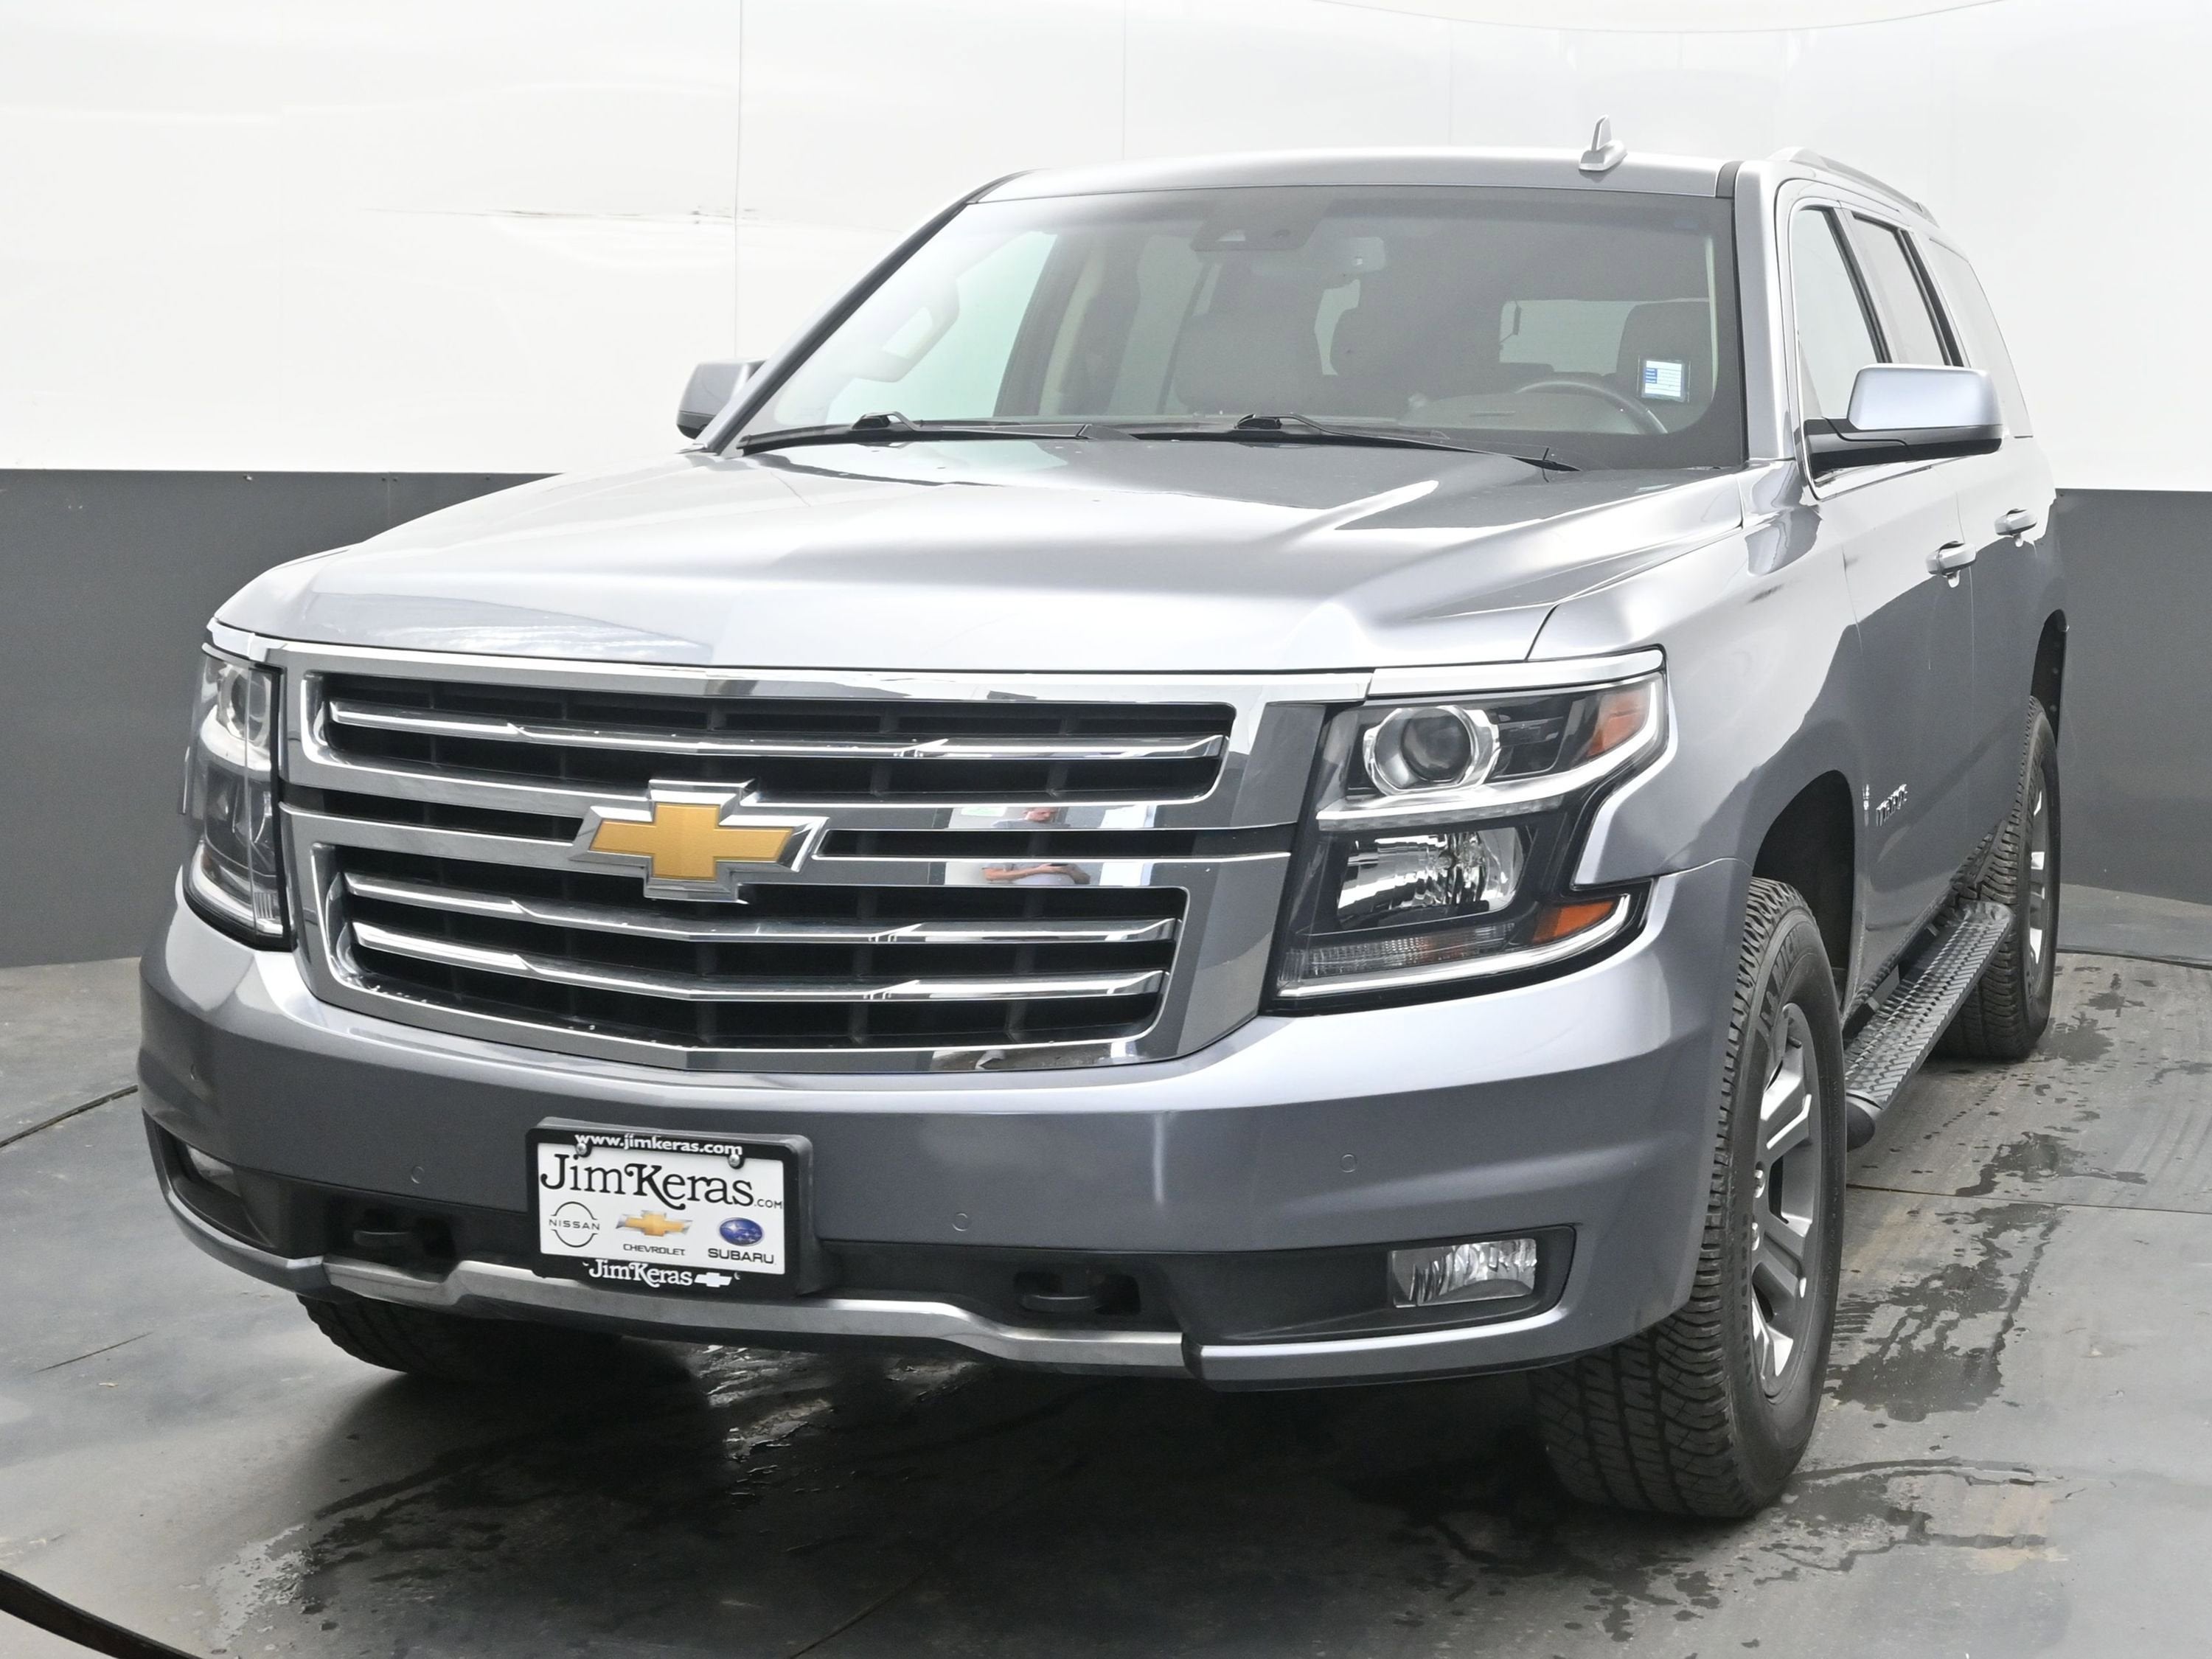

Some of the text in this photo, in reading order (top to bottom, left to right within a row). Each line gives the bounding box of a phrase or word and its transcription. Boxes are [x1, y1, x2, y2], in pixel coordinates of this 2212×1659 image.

[575, 1133, 742, 1155] www.jimkeras.com
[549, 1219, 600, 1231] NISSAN
[623, 1243, 685, 1256] CHEVROLET
[708, 1248, 774, 1265] SUBARU
[588, 1259, 693, 1288] JimKeras
